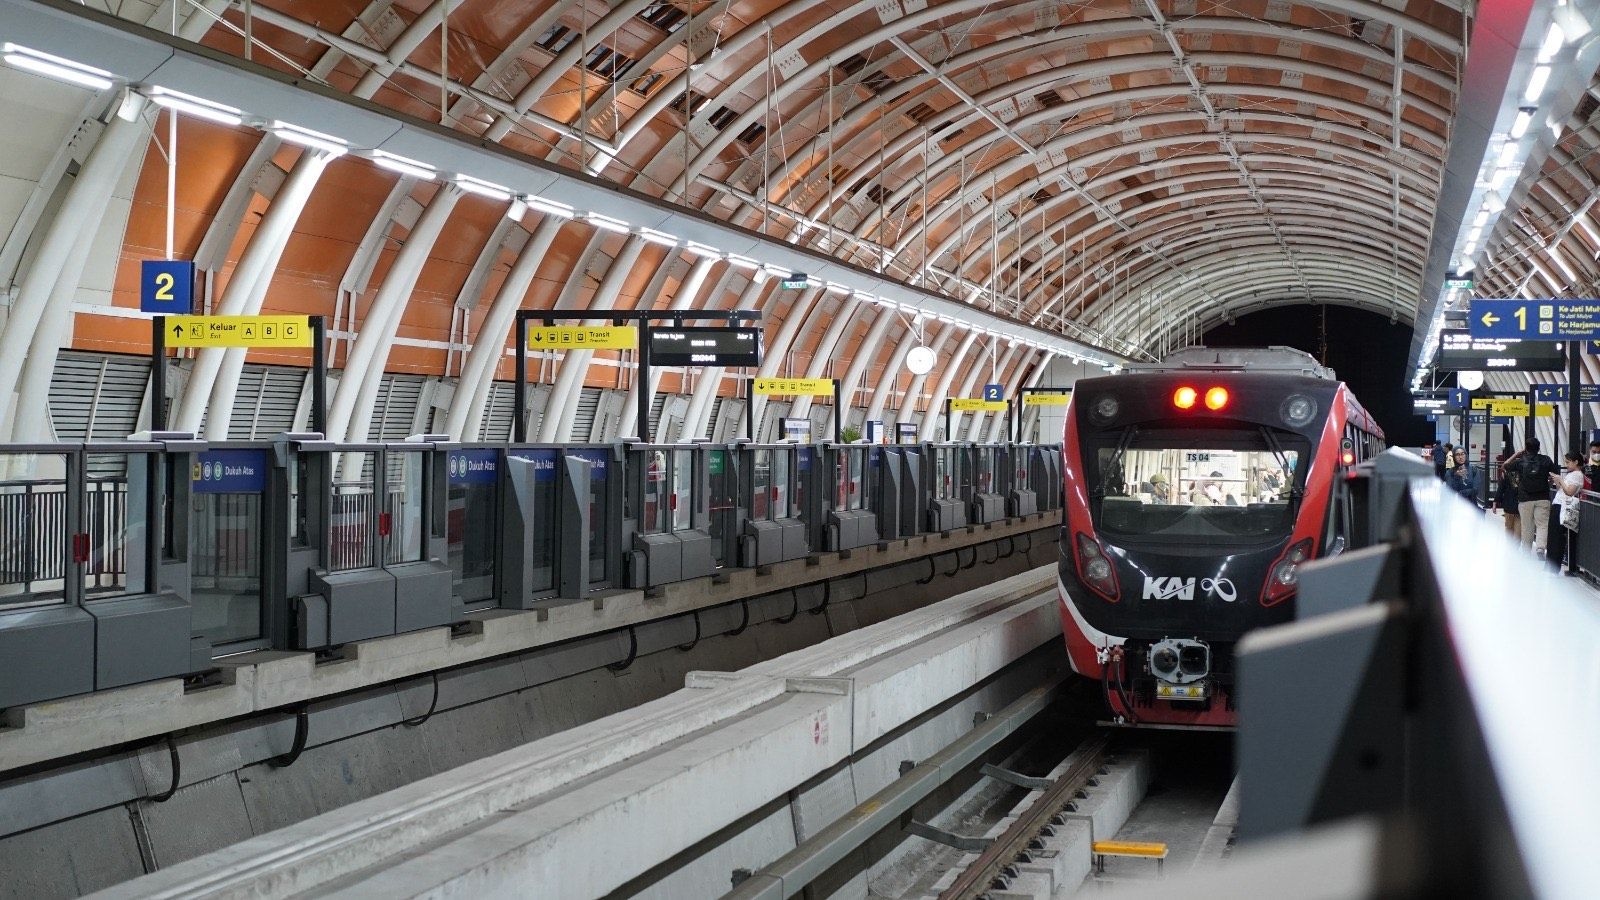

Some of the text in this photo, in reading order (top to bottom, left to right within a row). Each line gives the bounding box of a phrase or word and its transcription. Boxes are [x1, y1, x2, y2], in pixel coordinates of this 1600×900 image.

[155, 272, 174, 300] 2
[1570, 305, 1584, 313] Jati
[1514, 306, 1526, 330] 1
[210, 323, 236, 331] Keluar
[246, 327, 293, 335] A B C
[989, 388, 998, 399] 2
[1456, 392, 1462, 403] 1
[1557, 387, 1563, 398] 1
[1187, 453, 1197, 461] TS
[1198, 453, 1209, 461] 04
[225, 465, 254, 475] Dukuh Atas
[468, 460, 495, 471] Dukuh Atas
[1142, 576, 1196, 600] KAI
